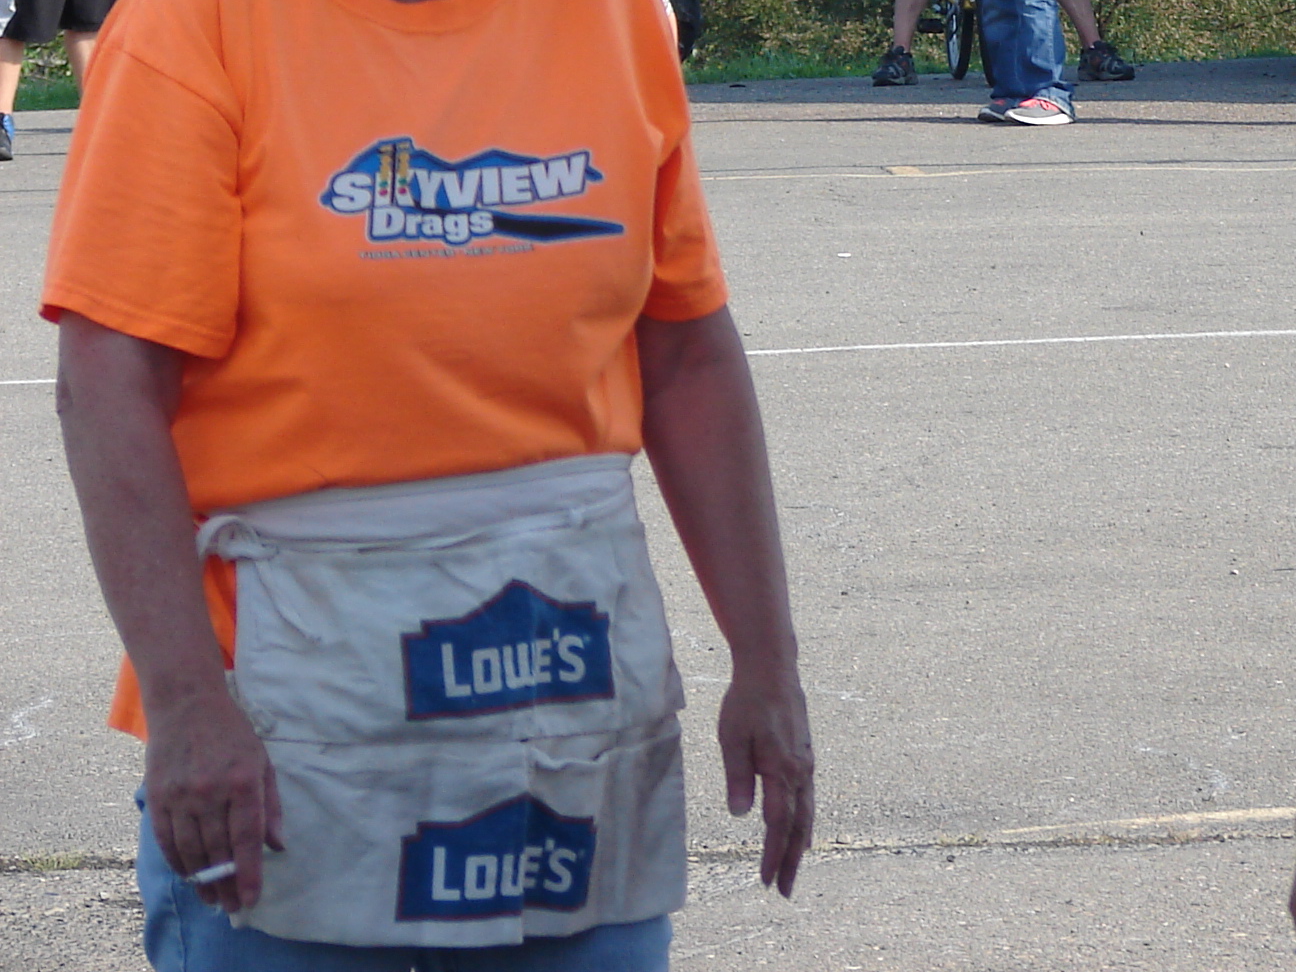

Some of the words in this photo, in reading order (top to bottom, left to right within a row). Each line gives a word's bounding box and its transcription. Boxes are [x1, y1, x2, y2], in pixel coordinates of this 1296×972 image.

[331, 152, 588, 212] SKYVIEW
[371, 206, 494, 241] Drags
[441, 628, 587, 699] LOWE'S
[431, 837, 577, 901] LOWE'S
